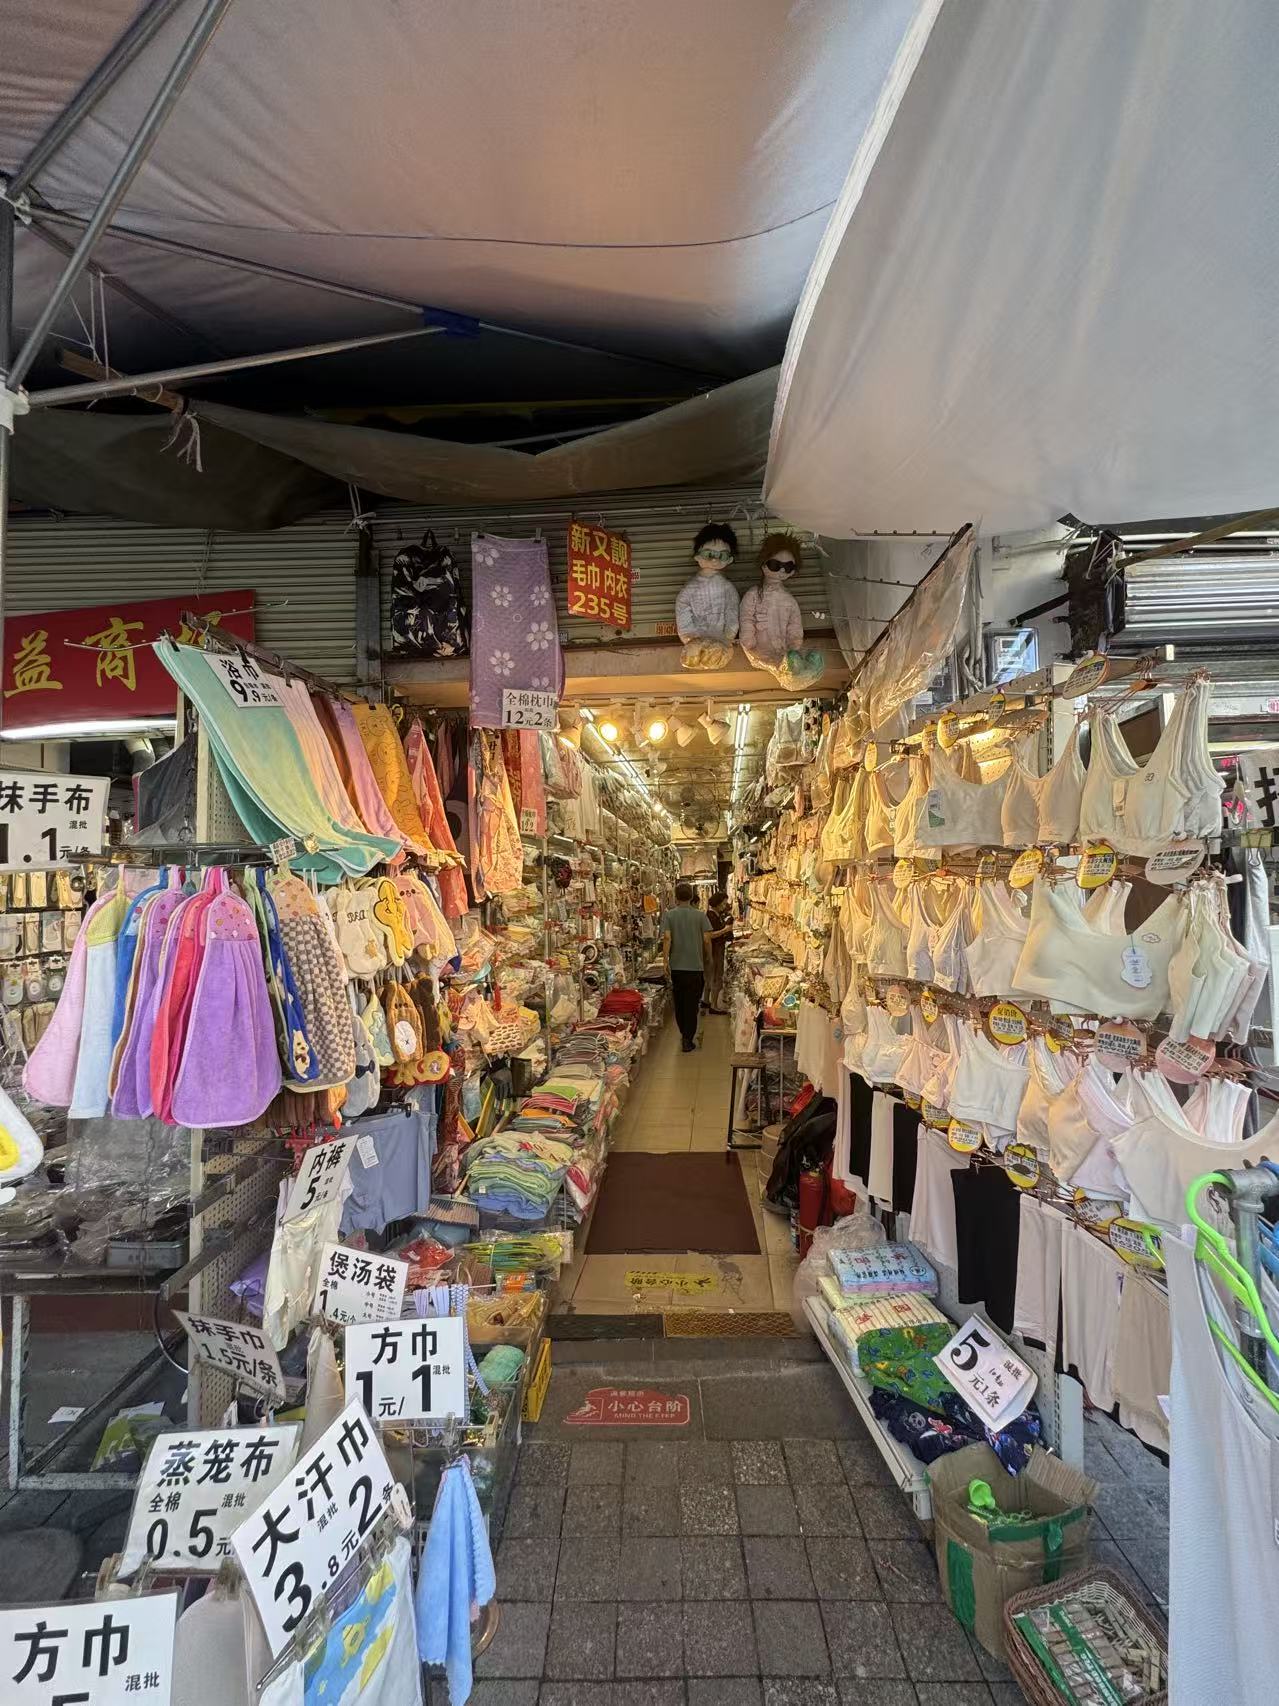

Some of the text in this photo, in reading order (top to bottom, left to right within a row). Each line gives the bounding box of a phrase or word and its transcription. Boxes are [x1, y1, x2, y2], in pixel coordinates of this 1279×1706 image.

[572, 559, 628, 599] 毛巾内衣
[572, 591, 628, 625] 235号
[505, 692, 553, 708] 全棉枕巾
[0, 781, 93, 814] 抹手布
[69, 820, 88, 830] 混批
[328, 1251, 396, 1293] 煲汤袋
[188, 1316, 264, 1350] 抹手巾
[371, 1323, 437, 1365] 方巾
[201, 1343, 278, 1387] 1.5元/条
[432, 1364, 451, 1375] 混批
[608, 1400, 683, 1412] 小心台阶
[157, 1435, 280, 1487] 蒸笼布
[148, 1491, 182, 1513] 全棉
[221, 1492, 246, 1508] 混批
[252, 1416, 369, 1577] 大汗巾
[316, 1502, 339, 1532] 混批
[12, 1614, 130, 1684] 方巾
[125, 1672, 160, 1692] 混批
